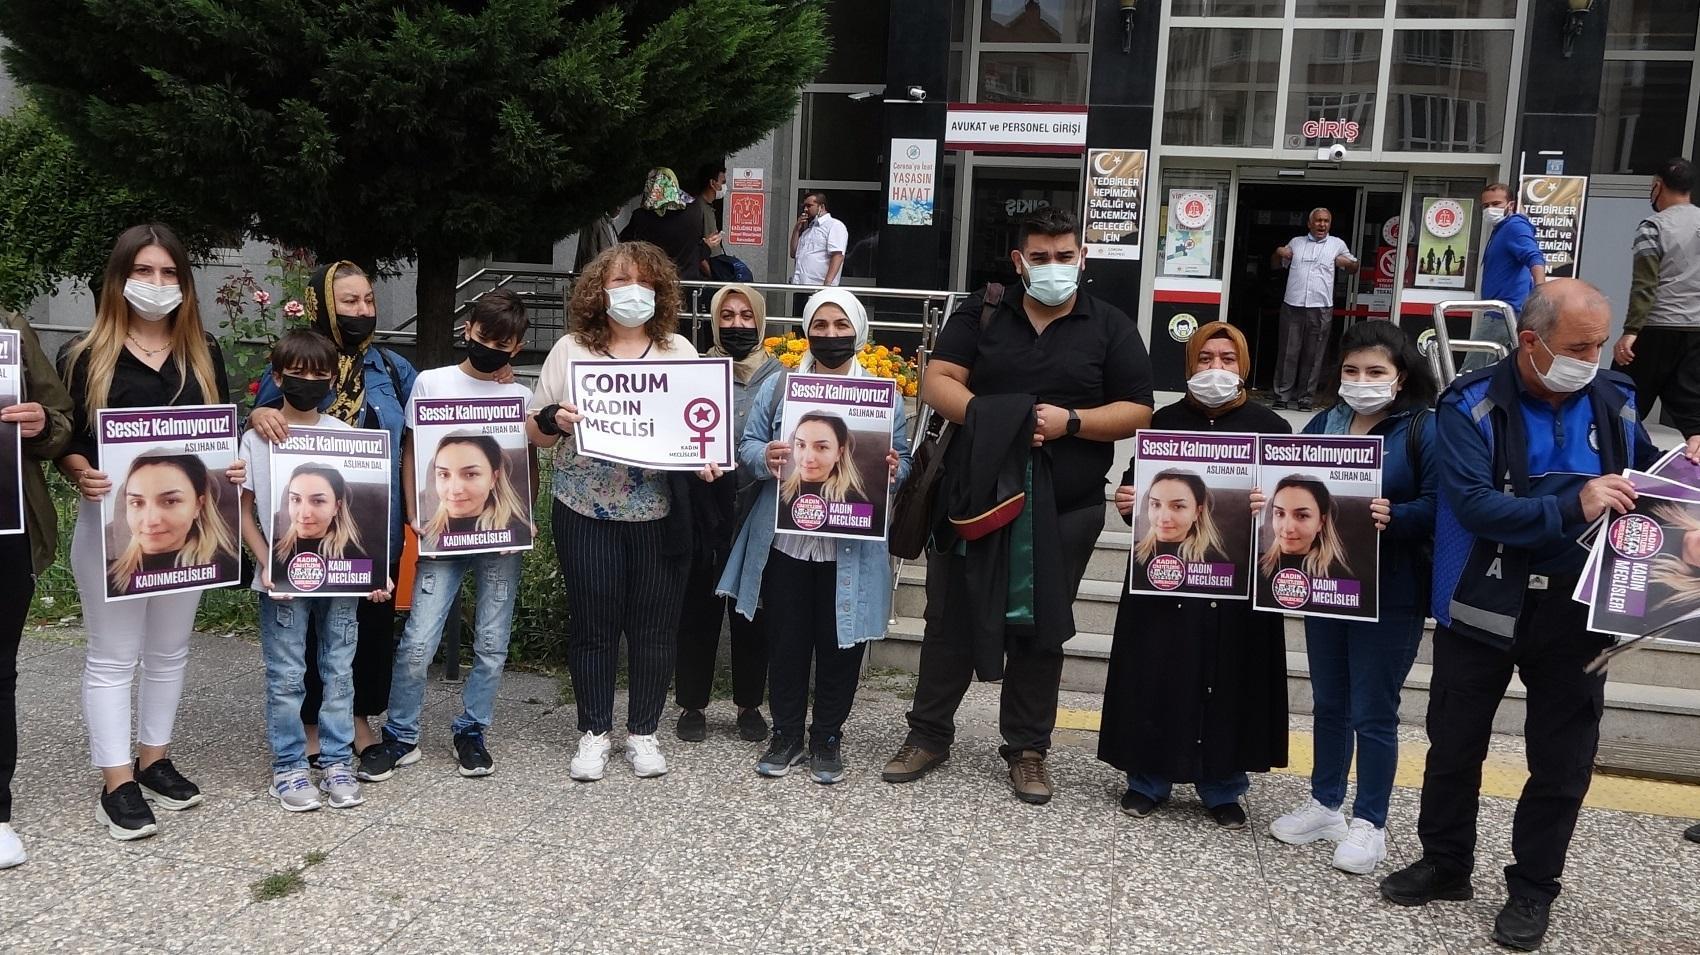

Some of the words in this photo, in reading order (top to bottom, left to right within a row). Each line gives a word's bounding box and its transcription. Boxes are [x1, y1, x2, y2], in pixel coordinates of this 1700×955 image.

[951, 121, 987, 131] AVUKAT
[1002, 122, 1048, 132] PERSONEL
[1052, 121, 1080, 136] GİRİŞİ
[1303, 118, 1358, 142] GİRİŞ
[893, 173, 932, 186] YAŞASIN
[1093, 176, 1139, 186] TEDBİRLER
[893, 187, 930, 201] HAYAT
[1093, 188, 1137, 198] HEPİMİZİN
[1090, 199, 1123, 209] SAĞLIĞI
[1524, 204, 1576, 215] TEDBİRLER
[1090, 210, 1137, 220] ÜLKEMİZİN
[1092, 221, 1132, 231] GELECEĞİ
[1104, 232, 1120, 243] İÇİN
[1534, 228, 1557, 239] ĞLIĞI
[1538, 240, 1572, 251] EMİZİN
[1545, 252, 1567, 262] CEĞİ
[582, 373, 668, 396] ÇORUM
[791, 382, 824, 398] Sessiz
[825, 384, 889, 403] Kalmıyoruz!
[420, 405, 454, 420] Sessiz
[456, 404, 520, 421] Kalmıyoruz!
[582, 398, 641, 416] KADIN
[848, 408, 874, 418] ASLIHAN
[876, 410, 886, 419] DAL
[106, 418, 150, 438] Sessiz
[152, 415, 230, 437] Kalmıyoruz!
[482, 426, 508, 434] ASLIHAN
[509, 425, 520, 433] DAL
[585, 417, 654, 437] MECLİSİ
[184, 442, 216, 453] ASLIHAN
[217, 441, 229, 450] DAL
[316, 436, 382, 454] Kalmıyoruz!
[1142, 440, 1179, 456] Sessiz
[1180, 441, 1251, 460] Kalmıyoruz!
[1265, 444, 1300, 461] Sessiz
[1302, 444, 1374, 465] Kalmıyoruz!
[344, 460, 370, 469] ASLIHAN
[371, 461, 382, 470] DAL
[1206, 465, 1235, 475] ASLIHAN
[1236, 467, 1248, 475] DAL
[1329, 471, 1358, 480] ASLIHAN
[1360, 472, 1372, 481] DAL
[830, 503, 852, 514] KADIN
[829, 514, 871, 527] MECLİSLERİ
[444, 530, 511, 547] KADINMECLİSLERİ
[328, 560, 351, 572] KADIN
[1188, 563, 1212, 574] KADIN
[136, 564, 216, 588] KADINMECLİSLERİ
[328, 571, 371, 584] MECLİSLERİ
[1188, 574, 1232, 586] MECLİSLERİ
[1630, 562, 1649, 592] KADIN
[1312, 578, 1337, 591] KADIN
[1608, 560, 1630, 613] MECLİSLERİ
[1312, 592, 1359, 606] MECLİSLERİ
